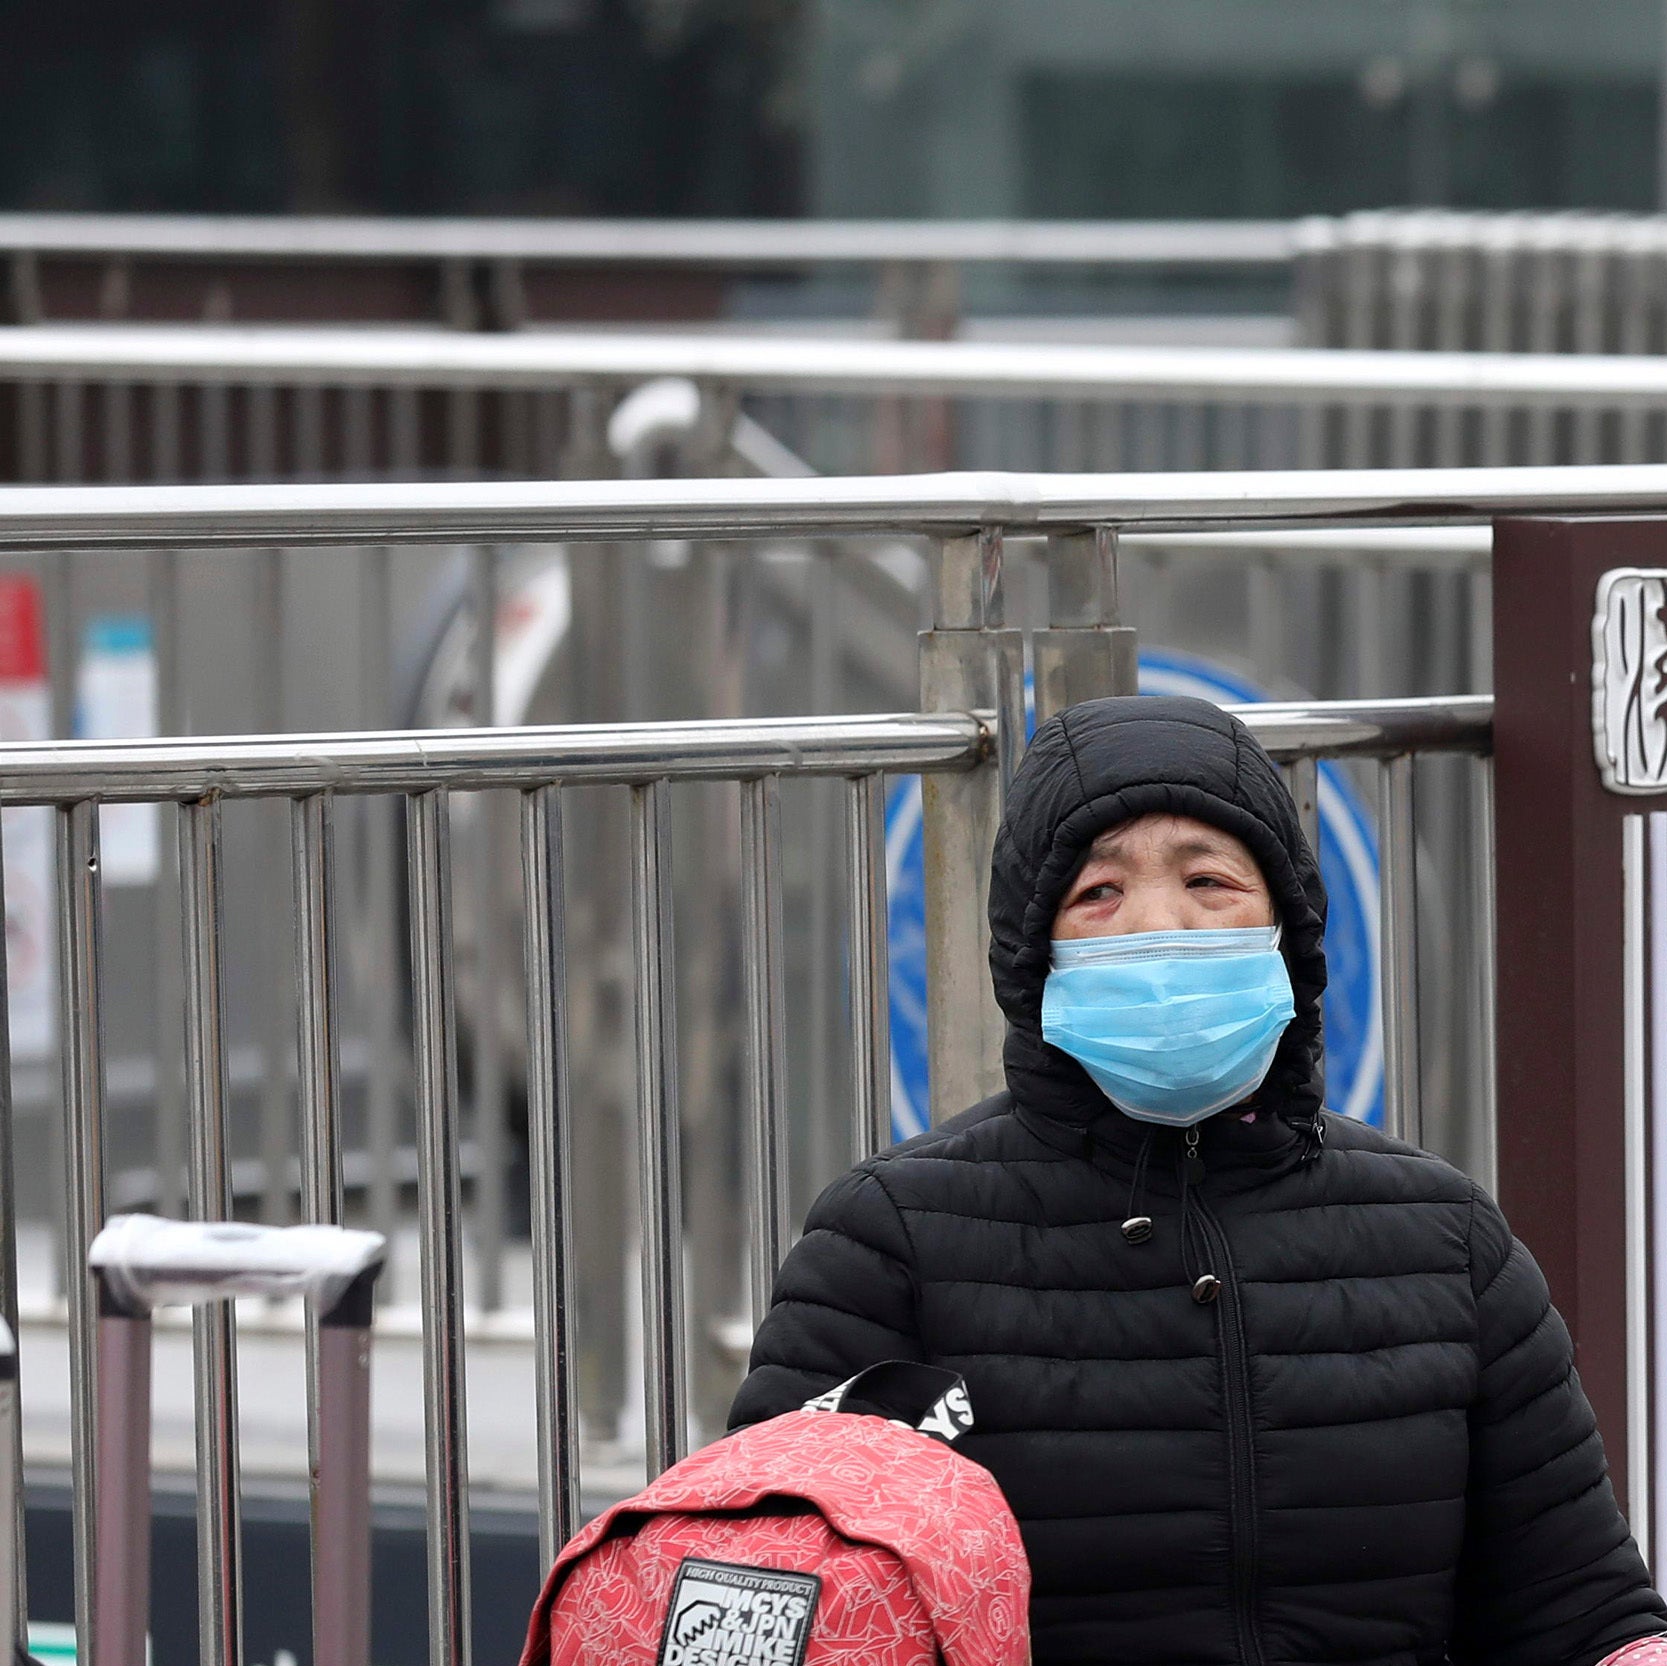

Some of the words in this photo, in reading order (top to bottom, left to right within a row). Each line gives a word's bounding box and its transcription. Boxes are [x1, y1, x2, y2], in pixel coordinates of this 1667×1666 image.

[686, 1566, 714, 1581] HIGH
[715, 1570, 761, 1589] QUALITY
[761, 1579, 813, 1595] PRODUCT
[719, 1587, 808, 1620] MCYS
[720, 1608, 798, 1641] &JPN
[713, 1628, 797, 1664] MIKE
